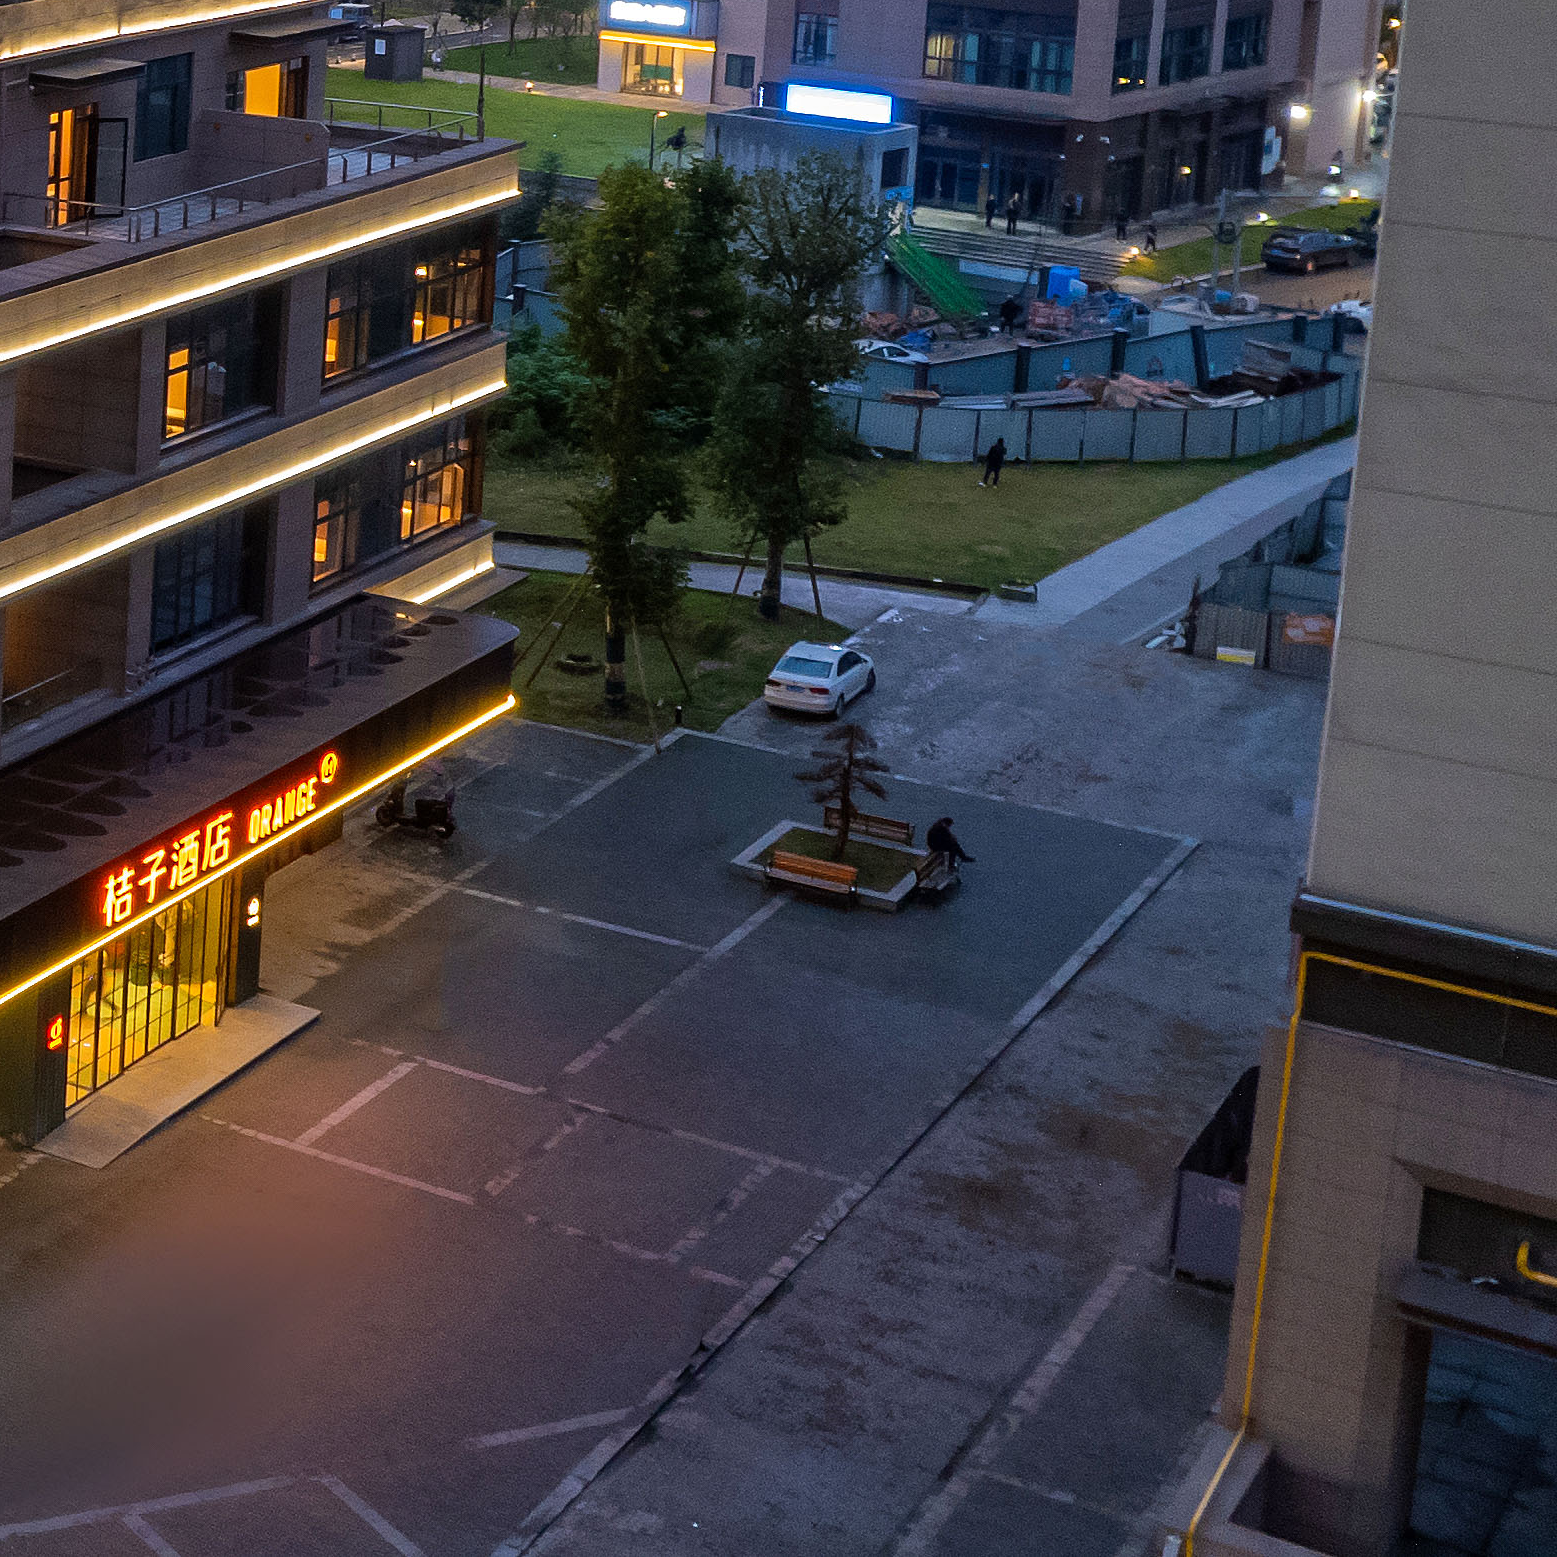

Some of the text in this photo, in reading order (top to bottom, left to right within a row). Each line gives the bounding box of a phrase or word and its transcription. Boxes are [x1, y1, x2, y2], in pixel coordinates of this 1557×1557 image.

[248, 776, 318, 844] ORANGE
[102, 812, 233, 928] 桔子酒店
